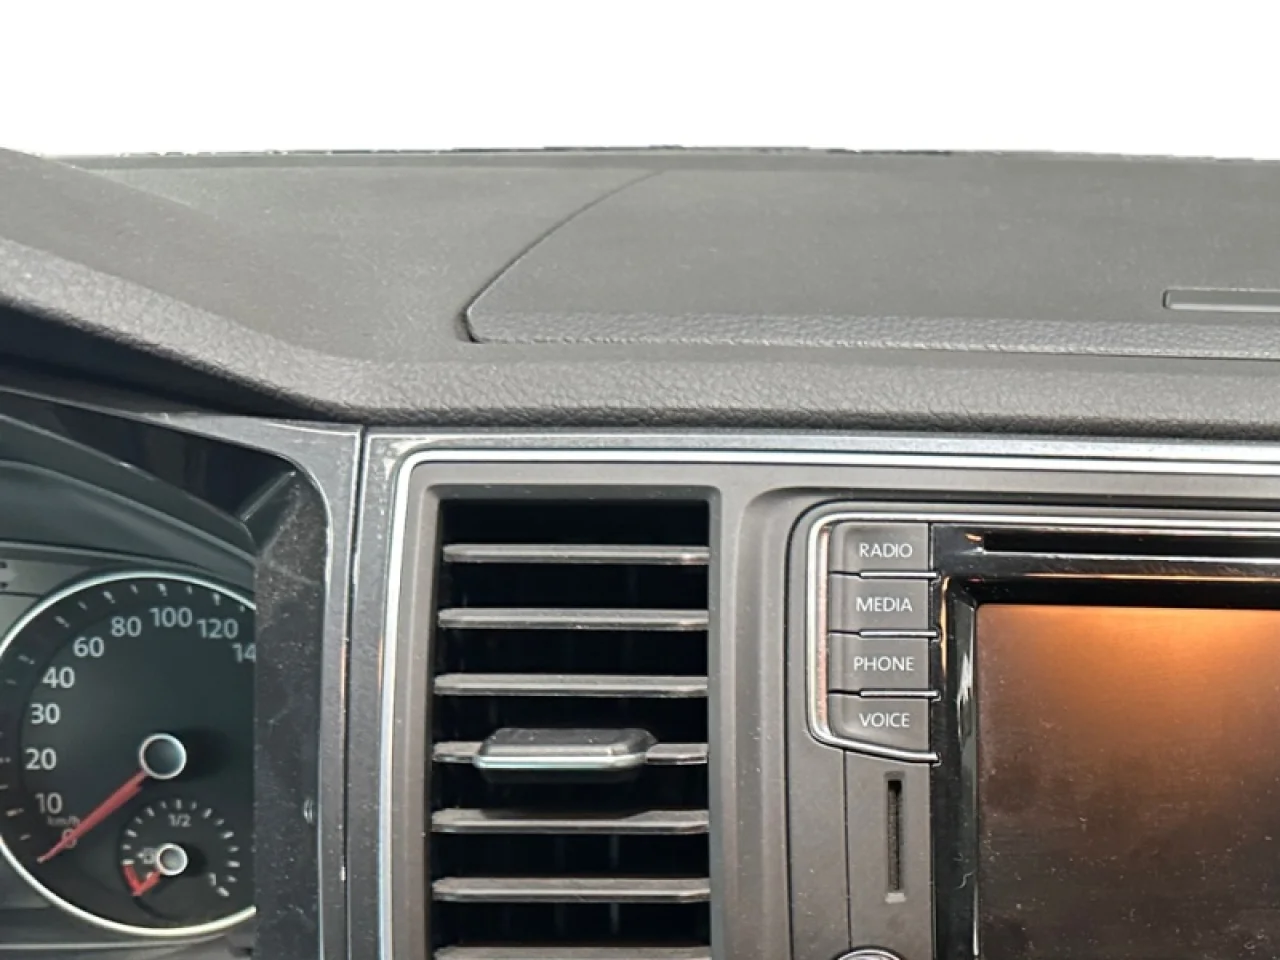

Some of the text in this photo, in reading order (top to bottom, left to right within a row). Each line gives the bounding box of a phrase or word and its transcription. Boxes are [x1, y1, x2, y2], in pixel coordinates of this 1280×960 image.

[858, 543, 913, 558] RADIO
[855, 597, 913, 612] MEDIA
[110, 615, 142, 638] 80
[149, 607, 193, 628] 100
[197, 618, 239, 639] 120
[72, 636, 105, 658] 60
[231, 643, 257, 663] 14
[853, 656, 915, 672] PHONE
[42, 666, 76, 689] 40
[30, 703, 61, 725] 30
[858, 713, 911, 729] VOICE
[25, 747, 57, 770] 20
[35, 792, 63, 814] 10
[168, 814, 192, 828] 1/2
